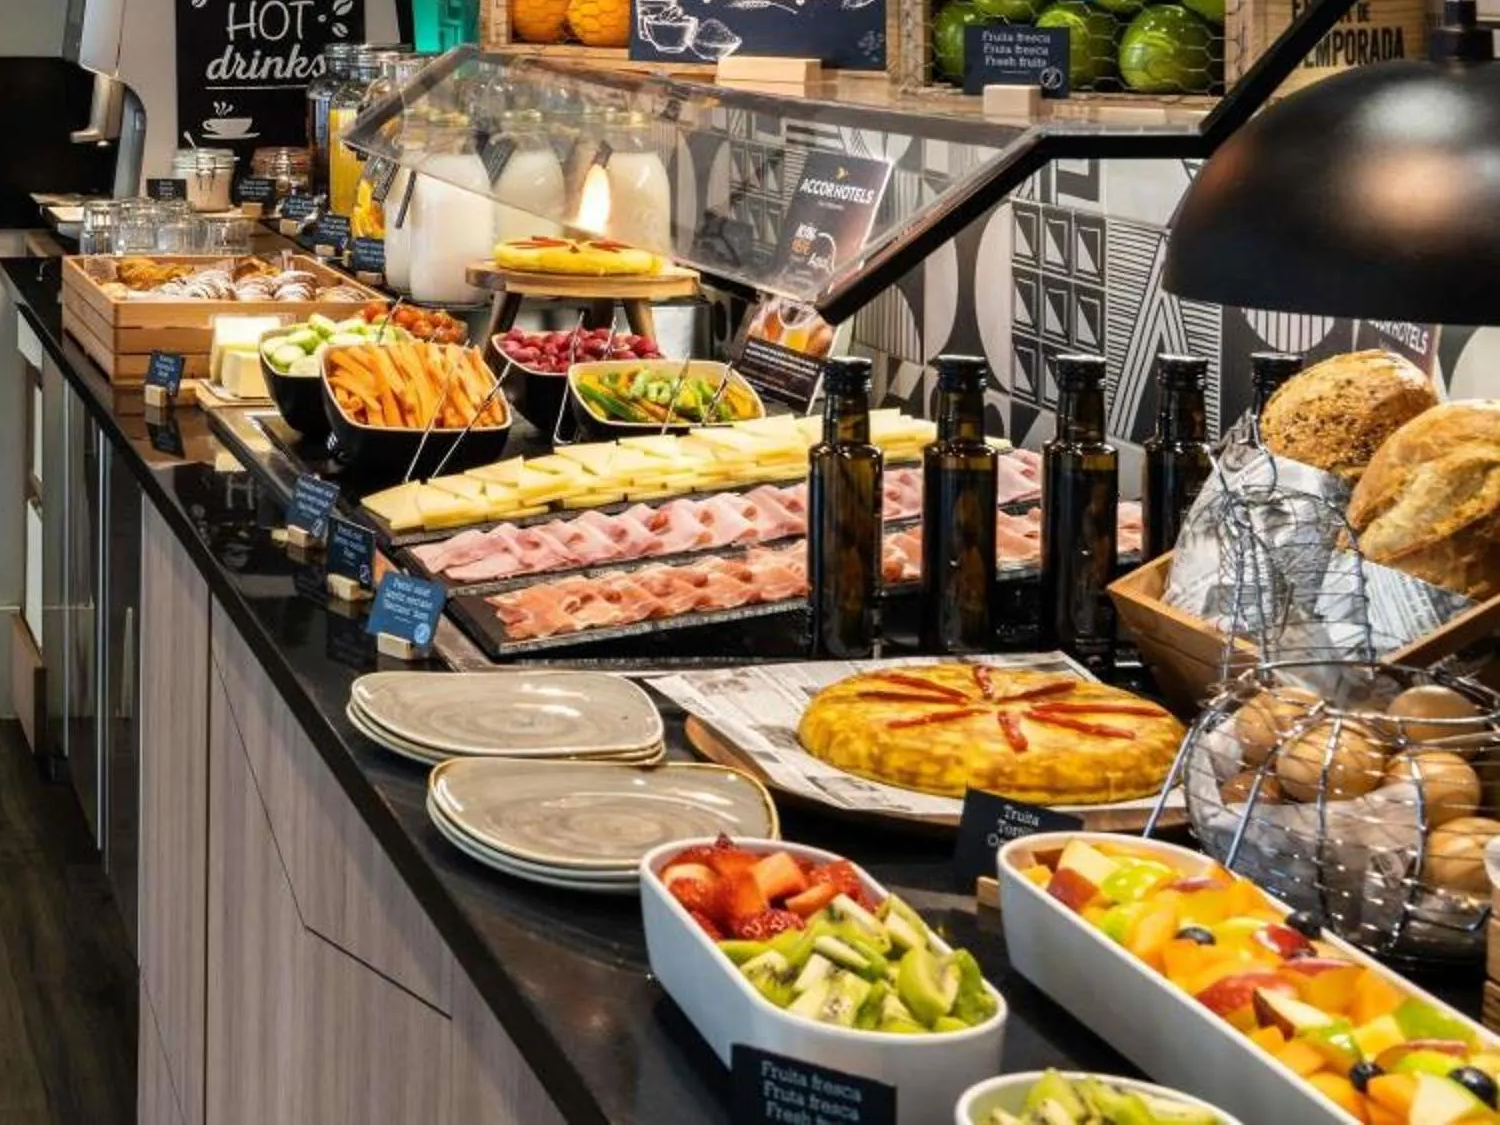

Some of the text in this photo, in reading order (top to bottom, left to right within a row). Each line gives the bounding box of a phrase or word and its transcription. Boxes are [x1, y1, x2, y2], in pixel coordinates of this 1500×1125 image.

[225, 0, 315, 41] HOT
[205, 44, 328, 80] drinks
[799, 177, 876, 204] ACCORHOTELS
[762, 1079, 861, 1122] Fruta fresca
[810, 1070, 863, 1102] fresca
